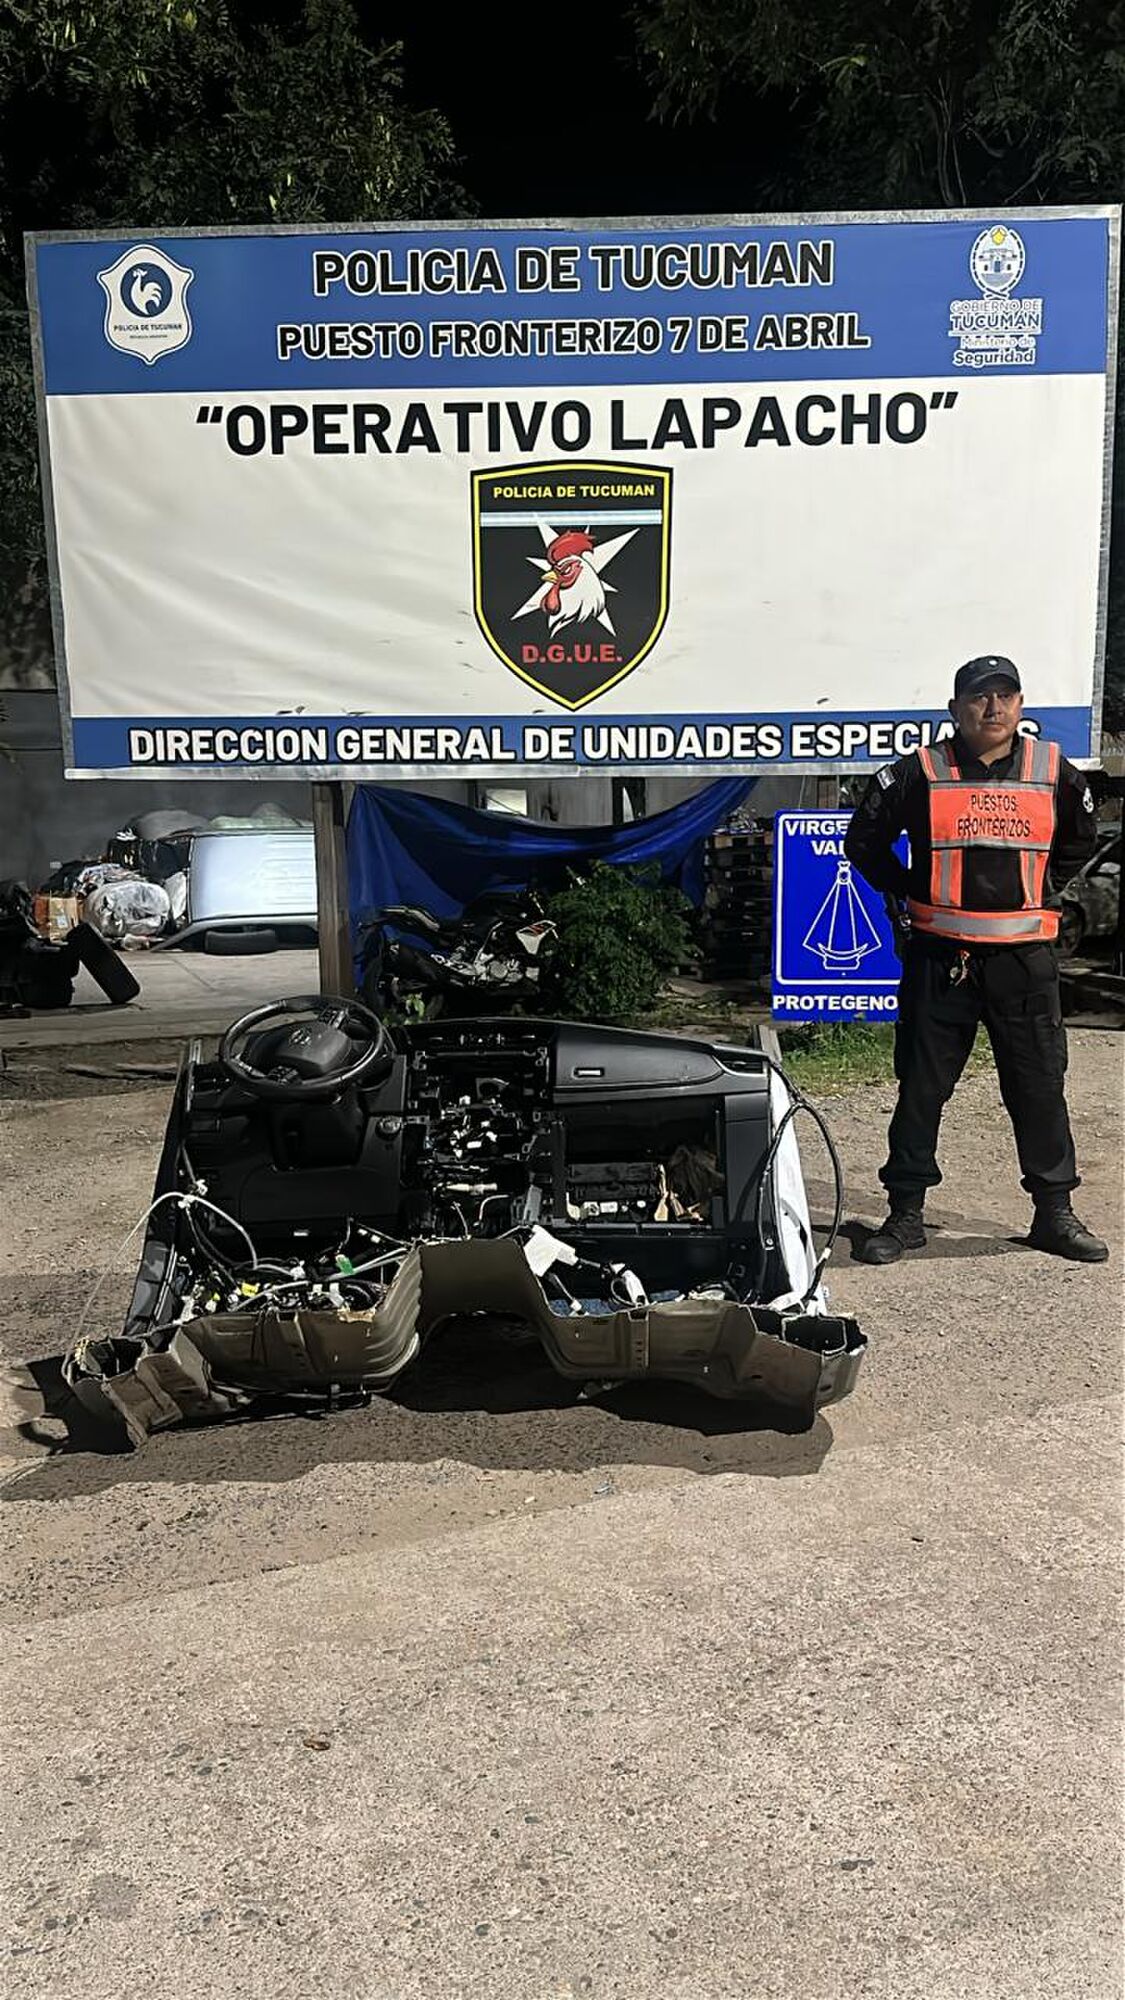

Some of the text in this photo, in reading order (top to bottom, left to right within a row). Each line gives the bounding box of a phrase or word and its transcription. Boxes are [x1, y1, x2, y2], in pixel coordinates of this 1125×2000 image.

[314, 240, 834, 296] POLICIA DE TUCUMAN
[950, 299, 1039, 313] GOBIERNO DE
[277, 312, 871, 360] PUESTO FRONTERIZO 7 DE ABRIL
[955, 350, 1034, 366] Seguridad
[196, 391, 958, 456] "OPERATIVO LAPACHO"
[493, 484, 655, 499] POLICIA DE TUCUMAN
[521, 643, 623, 663] D.G.U.E.
[128, 718, 1040, 763] DIRECCION GENERAL DE UNIDADES ESPECIAS
[970, 794, 1017, 812] PUESTOS
[784, 820, 850, 836] VIRGE
[957, 816, 1031, 838] FRONTERIZOS
[811, 840, 846, 856] VAL
[772, 995, 898, 1011] PROTEGENO
